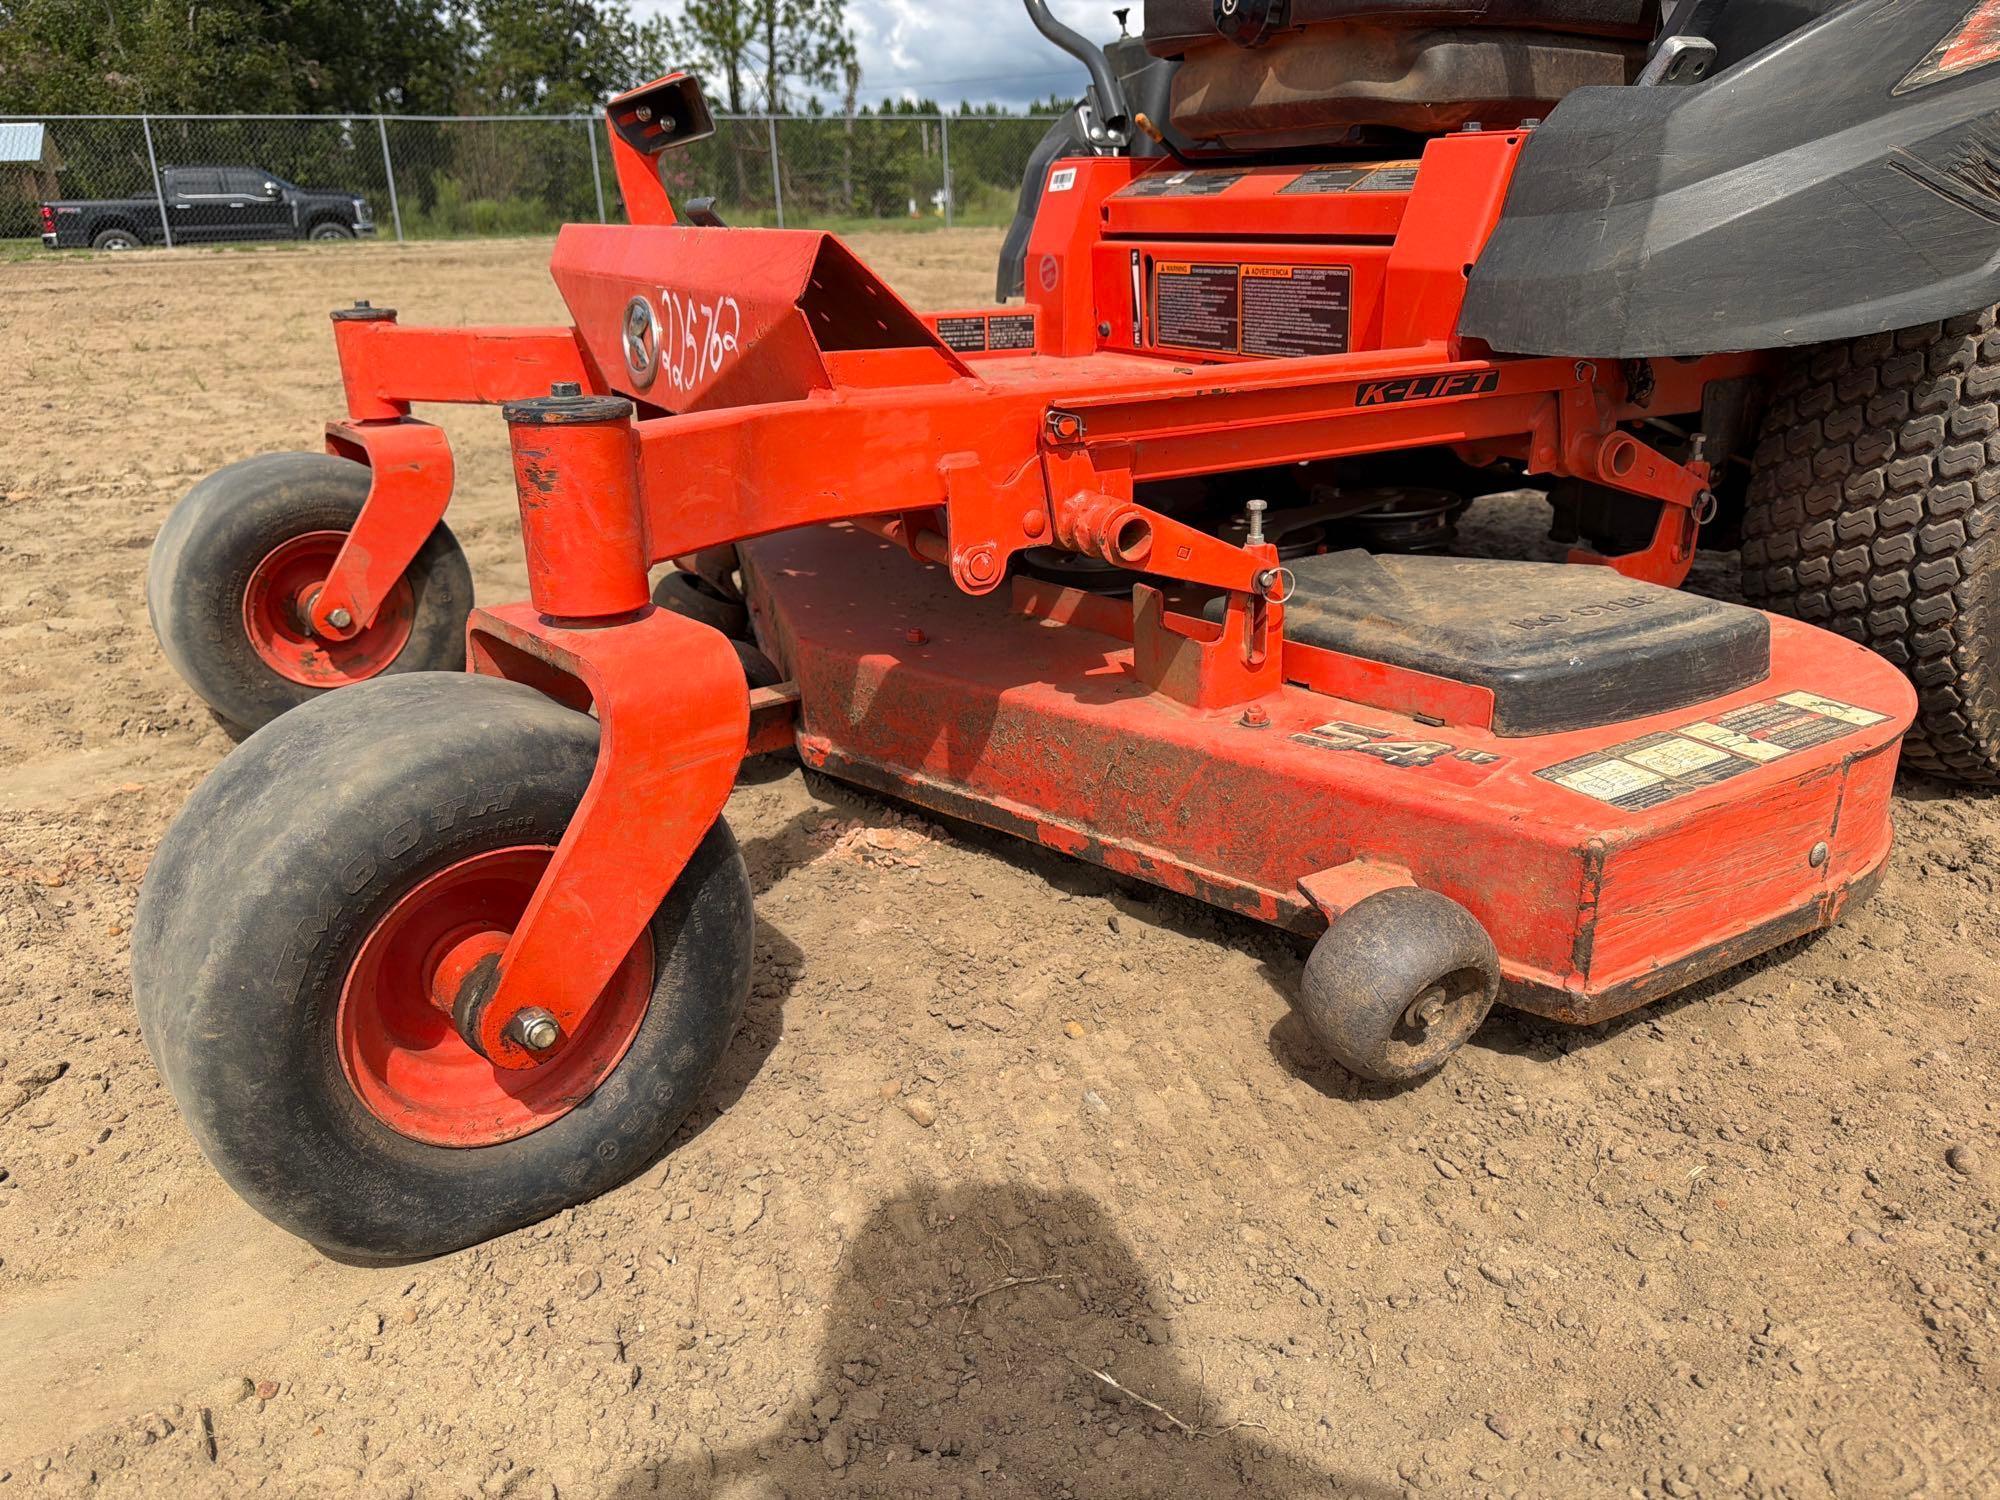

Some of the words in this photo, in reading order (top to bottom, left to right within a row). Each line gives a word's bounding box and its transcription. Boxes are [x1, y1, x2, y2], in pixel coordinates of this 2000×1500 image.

[1251, 267, 1289, 276] ADVERTENCIA
[661, 289, 740, 393] 225762
[1359, 371, 1497, 405] K-LIFT
[1288, 719, 1457, 768] 54
[272, 781, 525, 1005] SMOOTH
